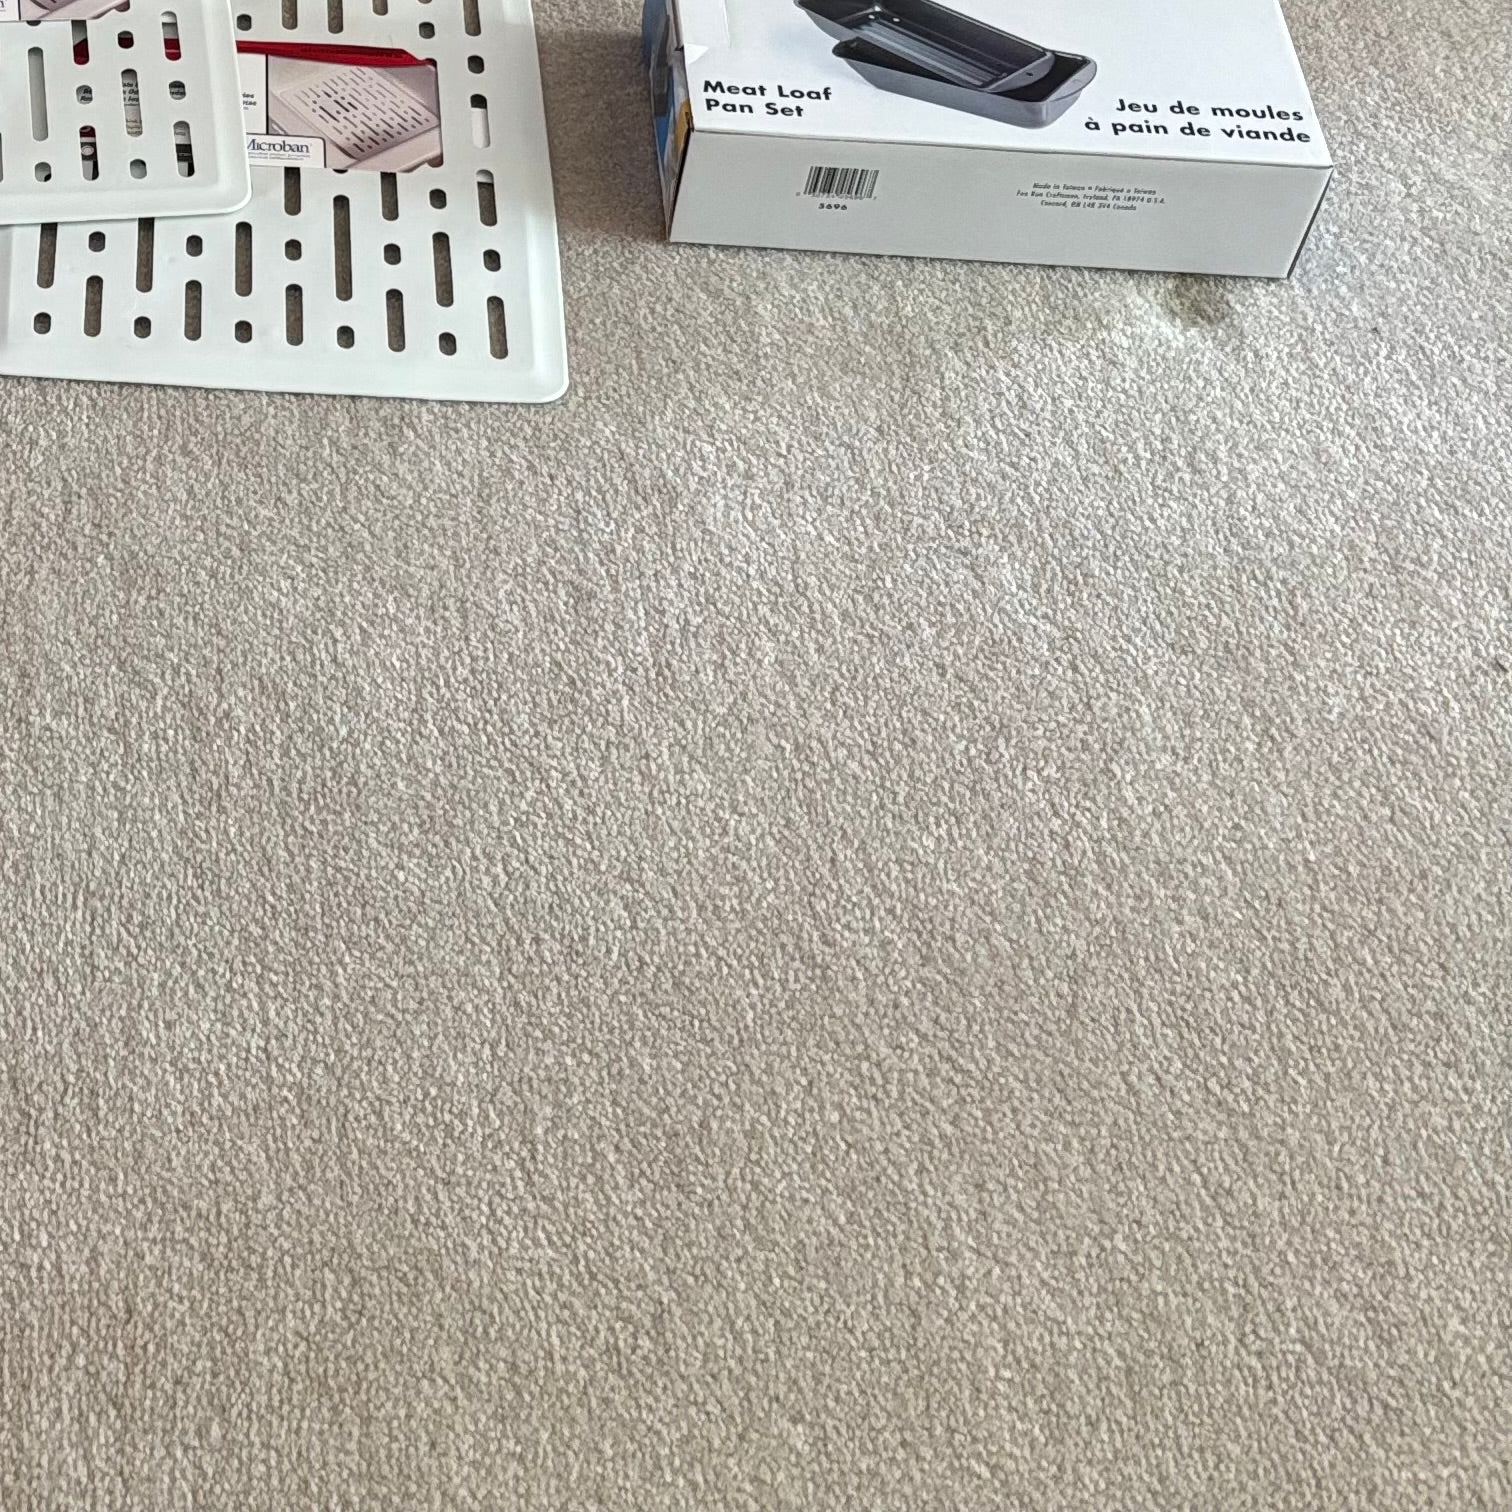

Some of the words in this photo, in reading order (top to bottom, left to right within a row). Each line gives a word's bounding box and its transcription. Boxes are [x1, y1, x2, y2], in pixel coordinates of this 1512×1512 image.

[703, 80, 767, 96] Meat
[777, 85, 833, 101] Loaf
[705, 98, 754, 114] Pan
[765, 102, 804, 117] Set
[1116, 98, 1158, 114] Jeu
[1169, 100, 1201, 116] de
[1211, 105, 1304, 122] moules
[1084, 117, 1101, 131] à
[1111, 119, 1169, 136] pain
[1179, 122, 1211, 137] de
[1220, 125, 1311, 143] viande
